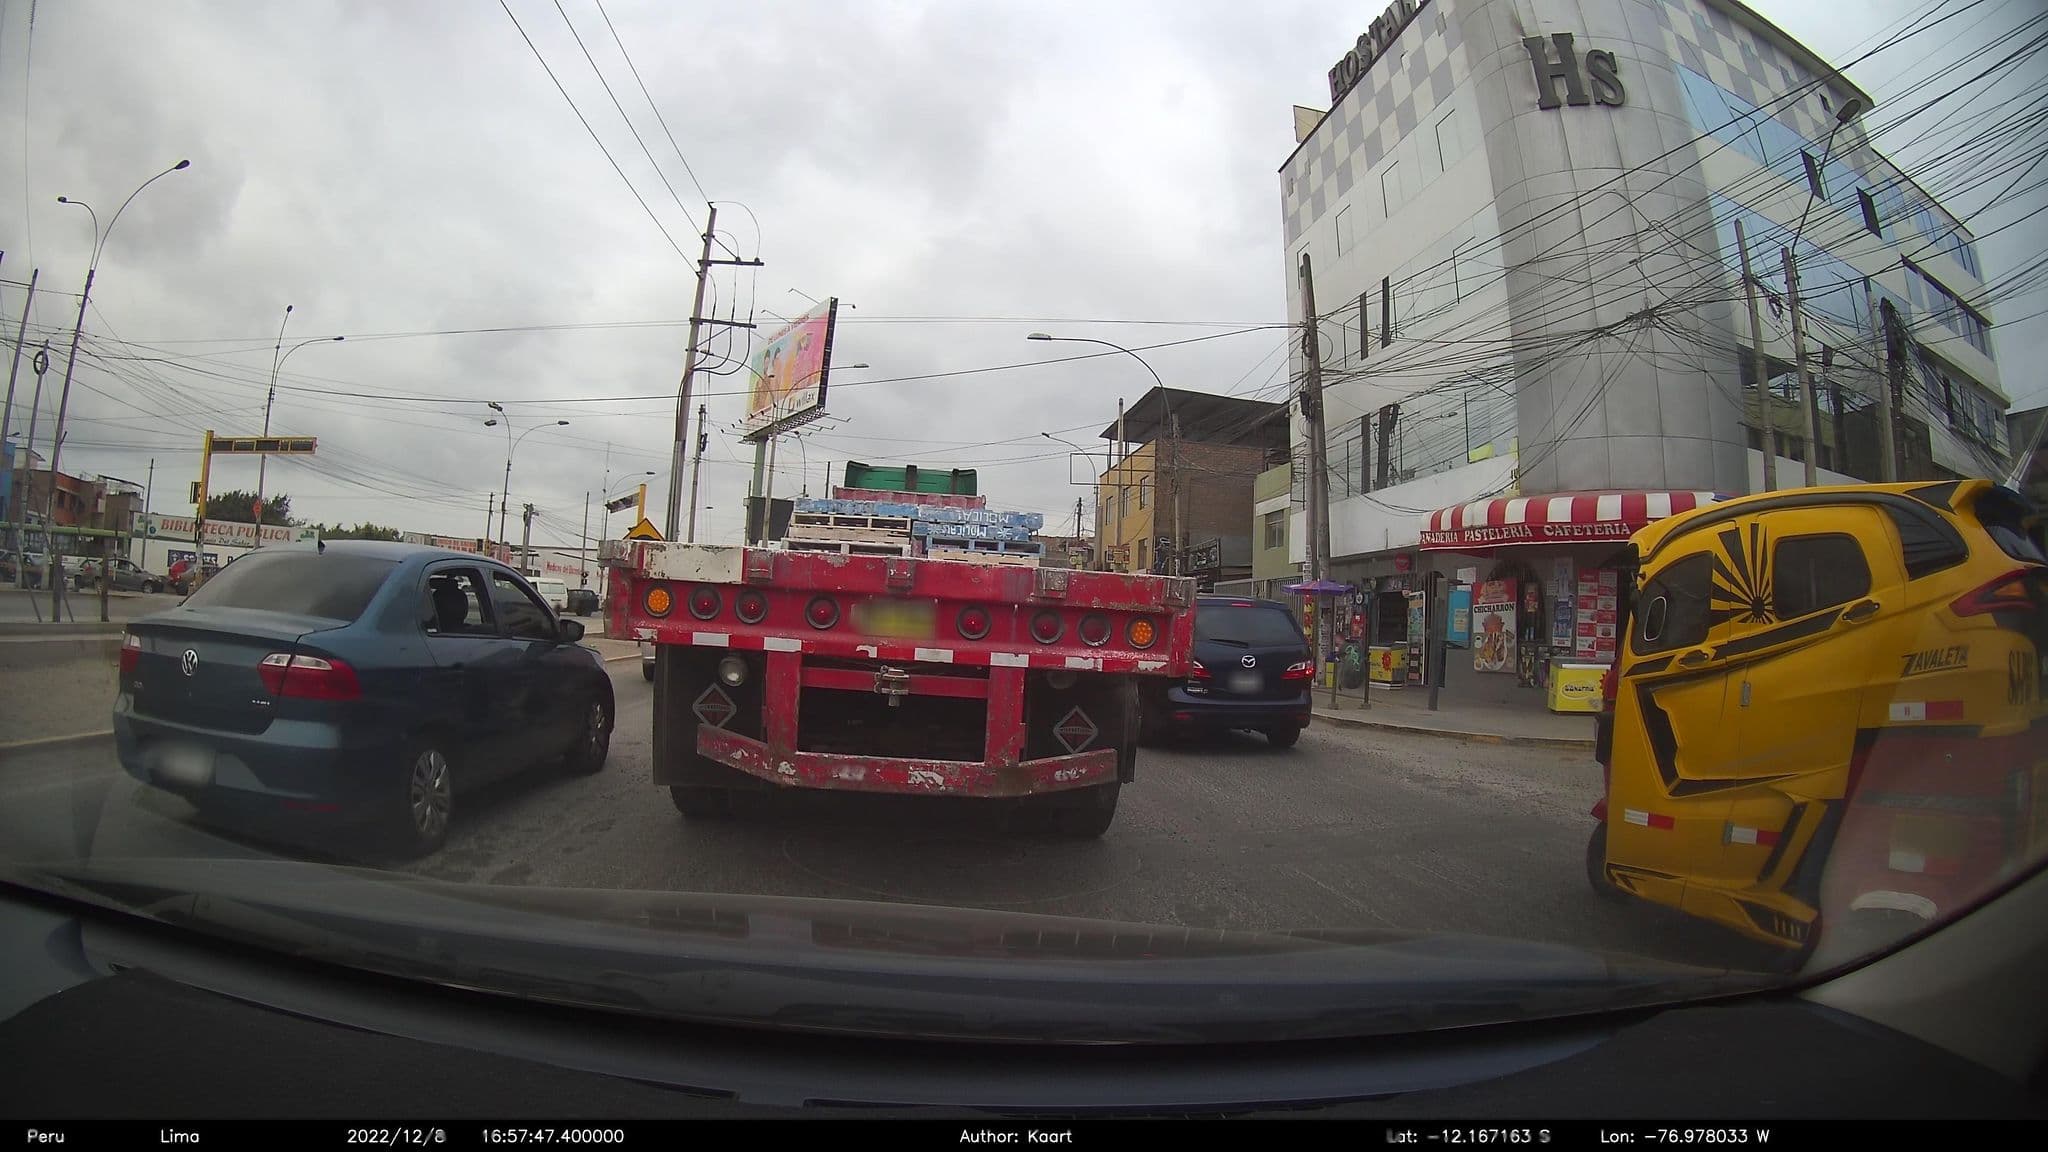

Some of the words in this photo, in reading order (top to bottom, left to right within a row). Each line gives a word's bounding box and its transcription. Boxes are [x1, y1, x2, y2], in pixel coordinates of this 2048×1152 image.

[161, 518, 234, 536] BIBLITECA
[1464, 525, 1533, 542] PASTELERIA
[1543, 522, 1631, 537] CAFETERIA
[1473, 602, 1515, 614] CHICHARRON
